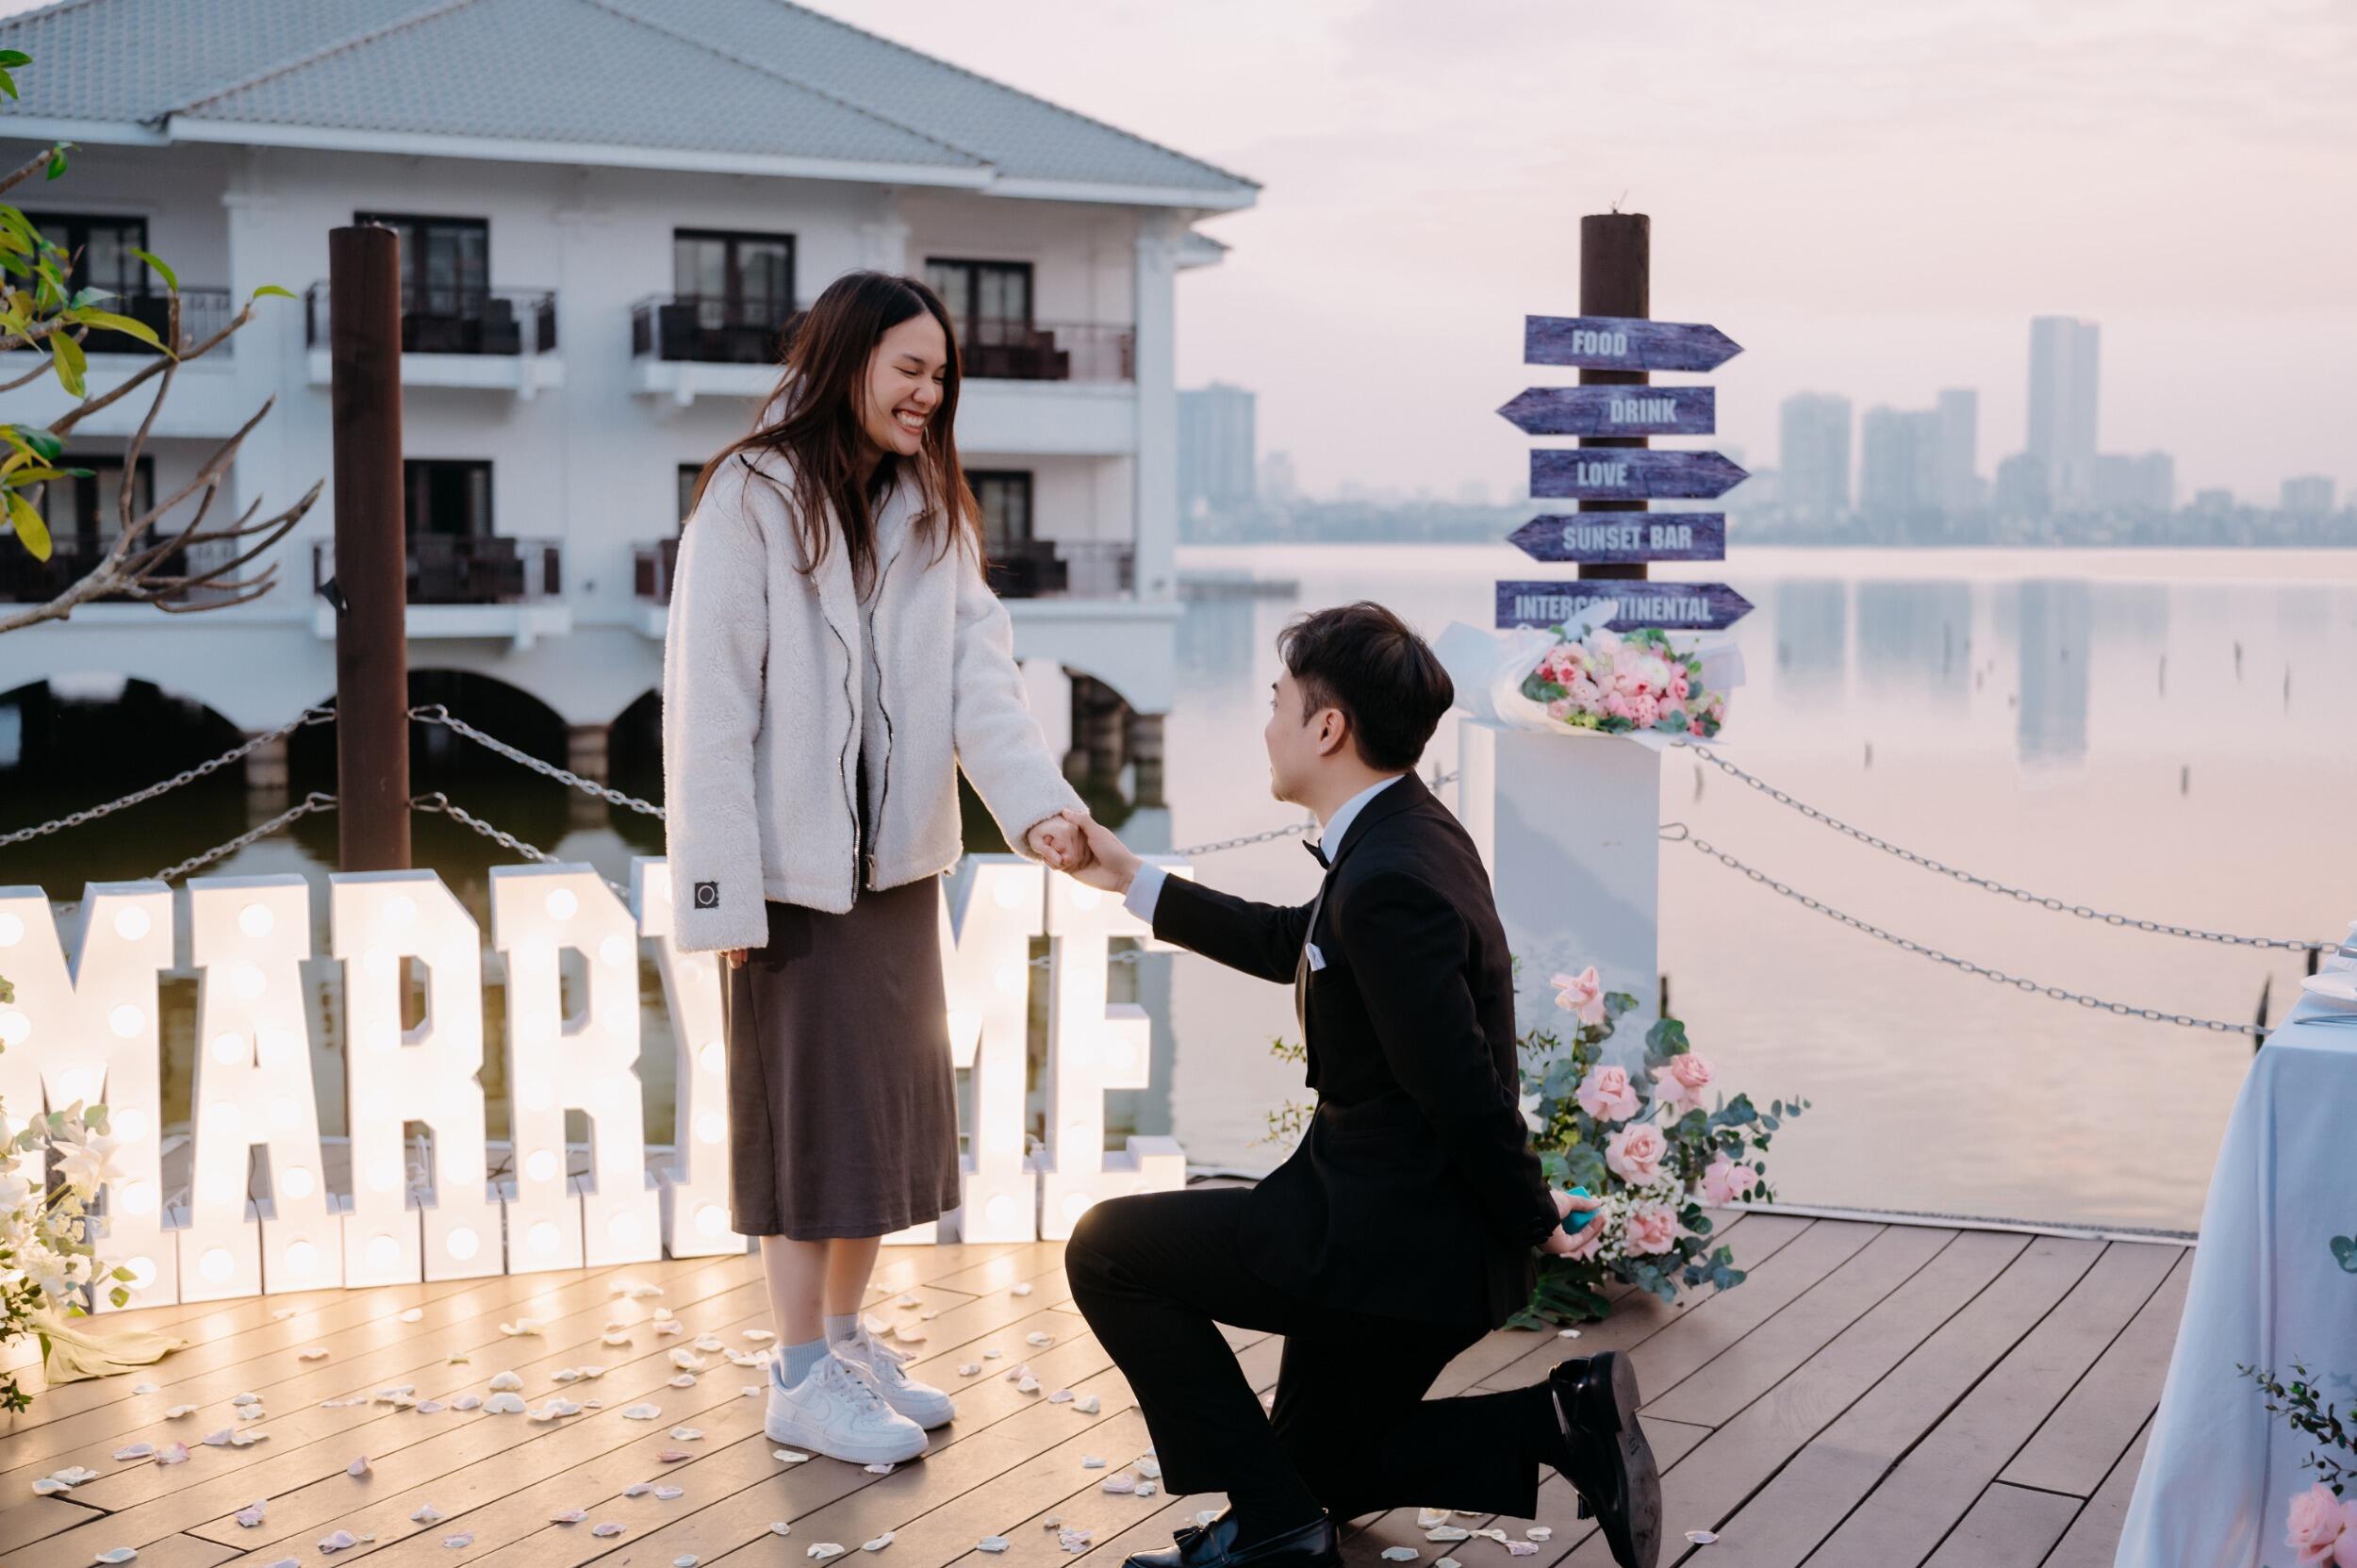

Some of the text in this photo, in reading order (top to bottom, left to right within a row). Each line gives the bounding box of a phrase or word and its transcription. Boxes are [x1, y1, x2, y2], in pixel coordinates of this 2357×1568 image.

[1572, 330, 1627, 356] FOOD
[1610, 399, 1677, 422] DRINK
[1577, 462, 1627, 487] LOVE
[1562, 525, 1692, 550] SUNSET BAR
[1515, 595, 1713, 621] INTERCTINENTAL
